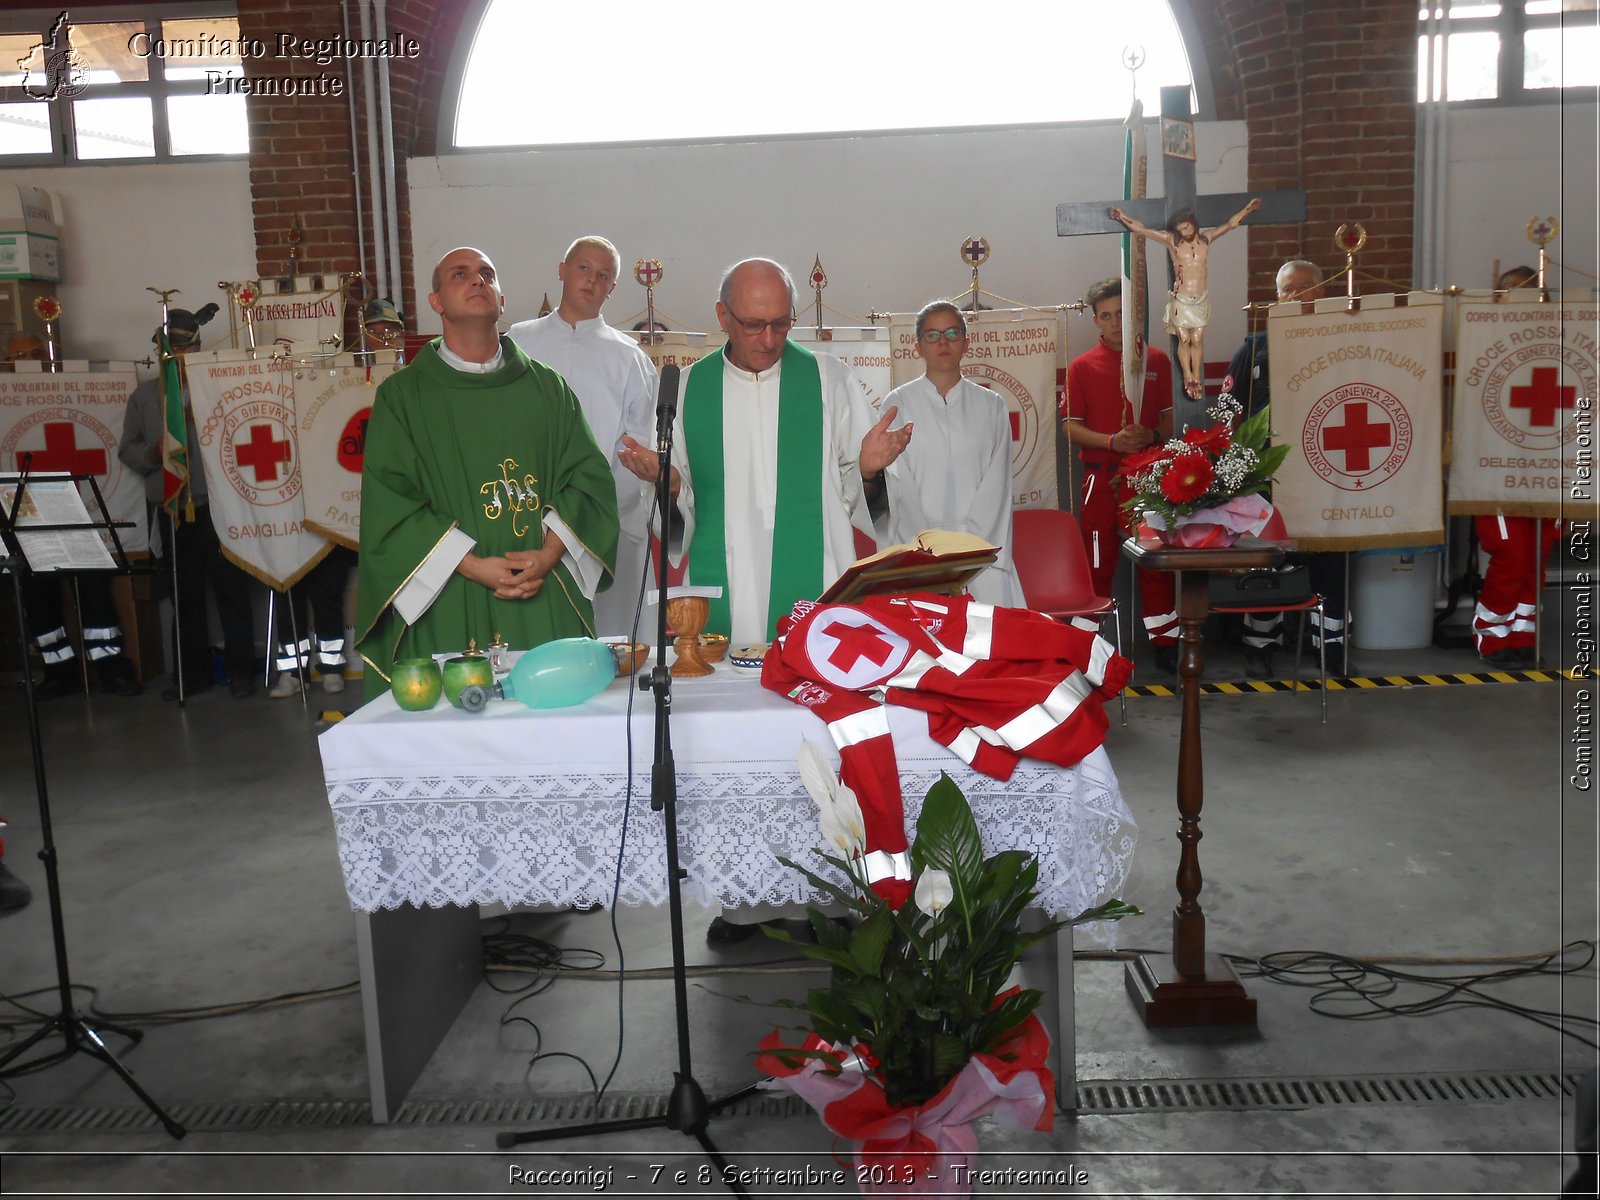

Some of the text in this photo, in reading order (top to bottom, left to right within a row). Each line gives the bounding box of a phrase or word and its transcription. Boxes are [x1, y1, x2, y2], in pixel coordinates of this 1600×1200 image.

[1466, 311, 1499, 323] CORPO
[1502, 310, 1555, 322] VOLONTARI
[984, 331, 1001, 343] DEL
[1005, 327, 1048, 342] SOCCORSO
[1285, 317, 1428, 340] CORPO VOLONTARI DEL SOCCORSO
[997, 342, 1057, 358] ITALIANA
[1466, 340, 1508, 388] CROCE
[1510, 326, 1566, 345] ROSSA
[249, 363, 263, 375] DEL
[1287, 345, 1427, 393] CROCE ROSSA ITALIANA
[1501, 358, 1516, 373] DI
[1573, 358, 1589, 374] 22
[12, 382, 59, 393] VOLONTARI
[64, 381, 80, 392] DEL
[85, 381, 126, 392] SOCCORSO
[222, 381, 274, 404] ROSSA
[985, 368, 995, 378] DI
[999, 373, 1034, 411] GINEVRA
[27, 394, 73, 406] ROSSA
[1485, 371, 1526, 445] CONVENZIONE
[227, 415, 239, 429] DI
[241, 403, 289, 422] GINEVRA
[3, 408, 118, 453] CONVENZIONE DI GINEVRA
[1304, 386, 1409, 478] CONVENZIONE DI GINEVRA 22 AGOSTO 1864
[1504, 475, 1571, 489] BARGE
[1030, 489, 1042, 502] DI
[1321, 505, 1395, 521] CENTALLO
